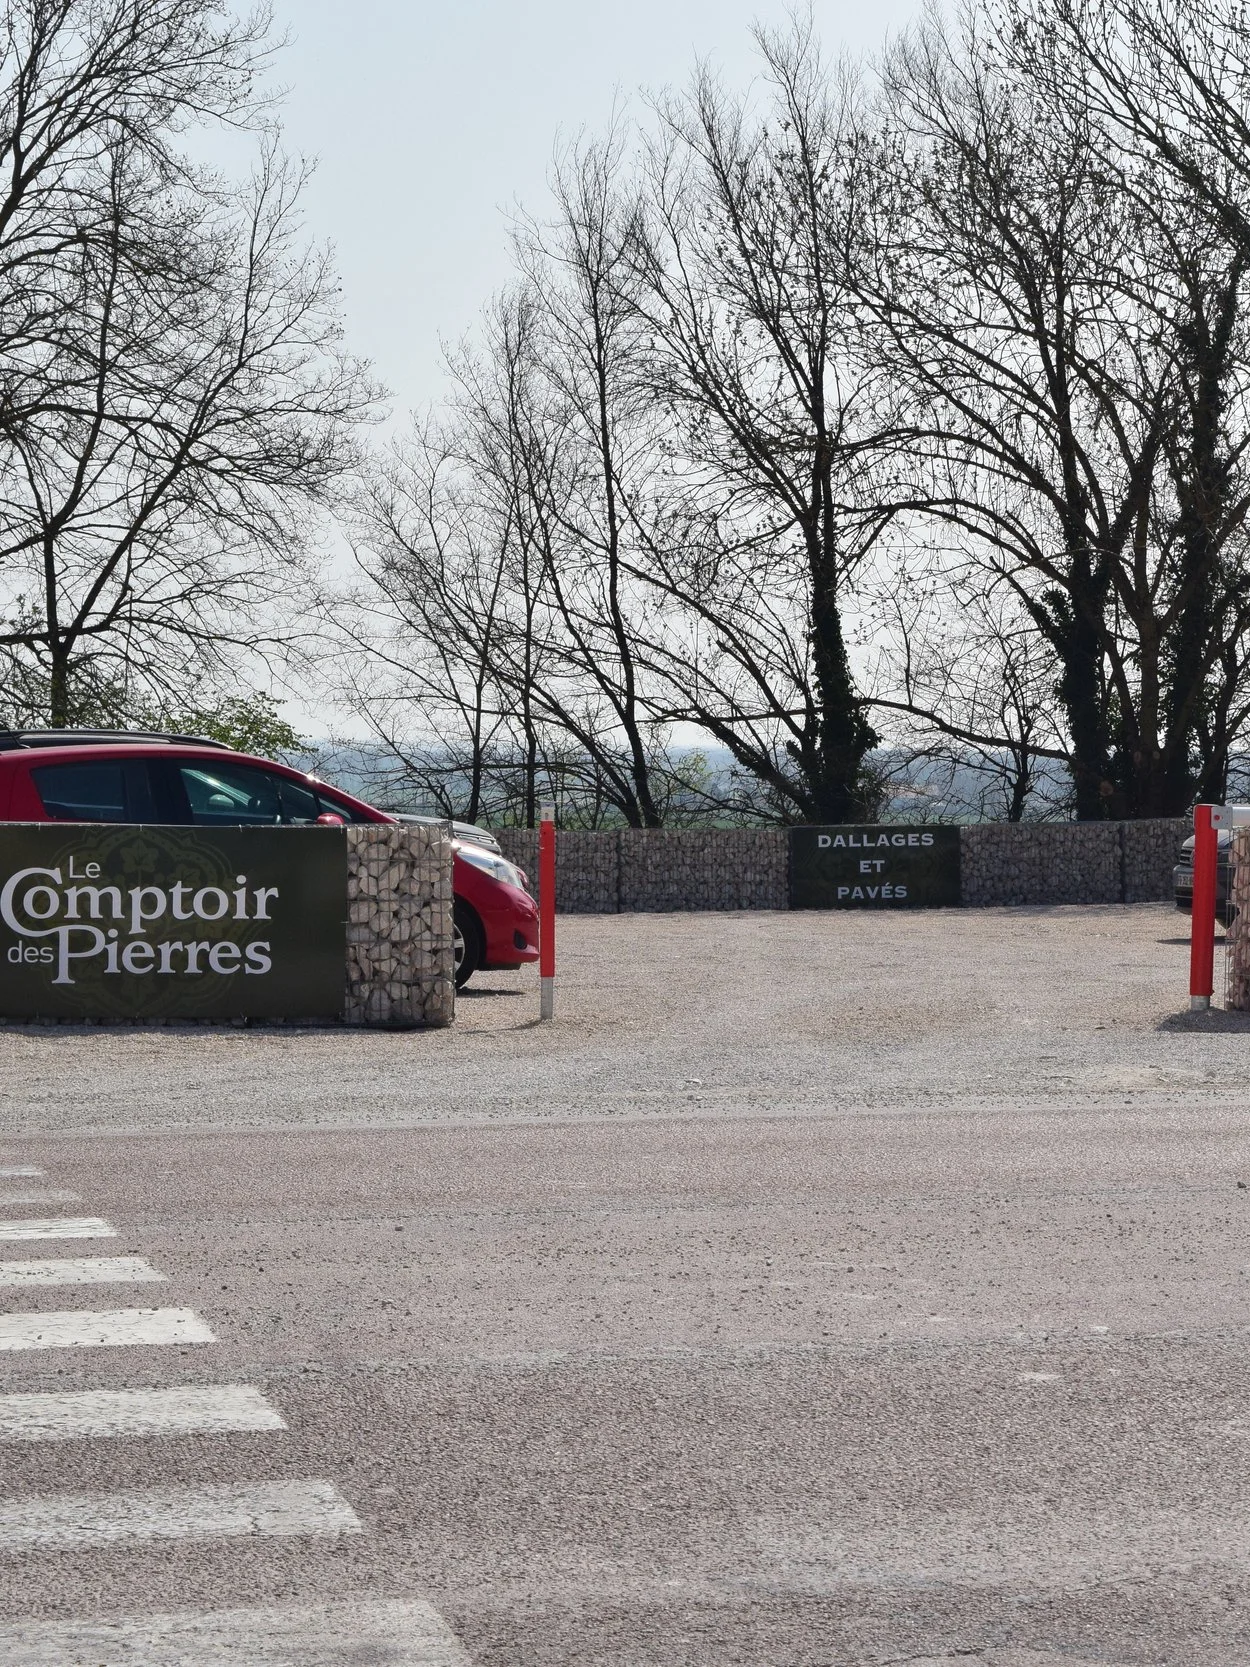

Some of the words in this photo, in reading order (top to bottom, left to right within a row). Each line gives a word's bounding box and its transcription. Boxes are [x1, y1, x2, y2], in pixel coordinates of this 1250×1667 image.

[818, 833, 934, 848] DALLAGES
[69, 856, 101, 879] Le
[859, 860, 885, 873] ET
[837, 882, 908, 899] PAVÉS
[0, 867, 279, 937] Comptoir
[7, 940, 54, 963] des
[51, 924, 272, 984] Pierres
